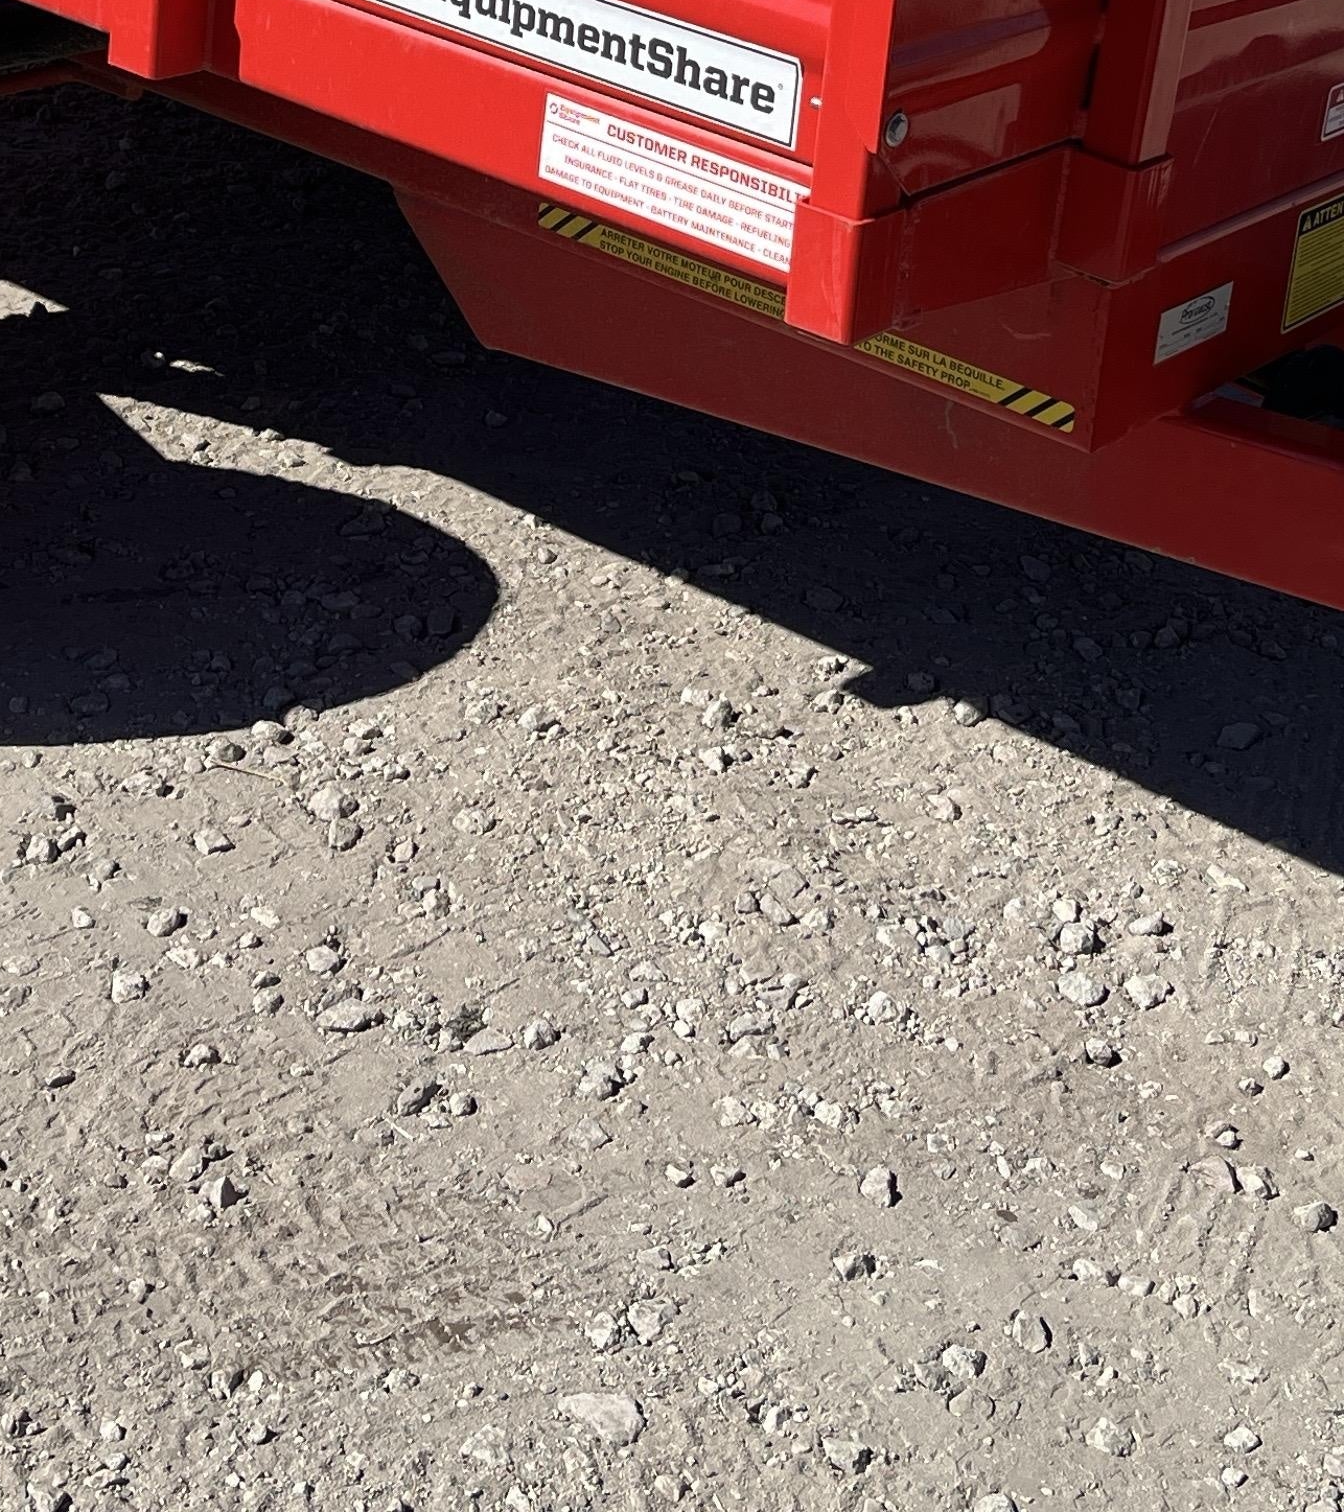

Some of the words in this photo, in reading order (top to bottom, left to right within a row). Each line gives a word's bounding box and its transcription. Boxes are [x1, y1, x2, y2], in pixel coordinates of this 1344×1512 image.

[606, 123, 687, 165] CUSTOMER
[544, 164, 580, 185] DAMAGE
[581, 177, 592, 190] TO
[594, 183, 644, 210] EQUIPMENT
[650, 204, 689, 229] BATTERY
[691, 220, 756, 255] MAINTENANCE
[552, 133, 578, 151] CHECK
[581, 144, 597, 158] ALL
[597, 149, 623, 167] FLUID
[624, 157, 655, 178] LEVELS
[665, 174, 699, 194] GREASE
[700, 187, 727, 205] DAILY
[728, 199, 762, 220] BEFORE
[764, 213, 794, 231] START
[564, 155, 613, 180] INSURANCE
[619, 175, 639, 191] FLAT
[641, 184, 667, 202] TIRES
[673, 196, 695, 212] TIRE
[696, 204, 734, 227] DAMAGE
[740, 221, 791, 249] REFUELING
[599, 241, 625, 257] STOP
[625, 250, 653, 268] YOUR
[654, 261, 690, 283] ENGINE
[692, 275, 733, 299] BEFORE
[600, 228, 646, 251] ARRETER
[647, 245, 678, 265] VOTRE
[680, 260, 721, 282] MOTEUR
[723, 274, 752, 293] POUR
[874, 344, 896, 360] THE
[896, 351, 939, 377] SAFETY
[907, 344, 930, 361] SUR
[932, 352, 947, 369] LA
[948, 357, 1005, 391] BEQUILLE
